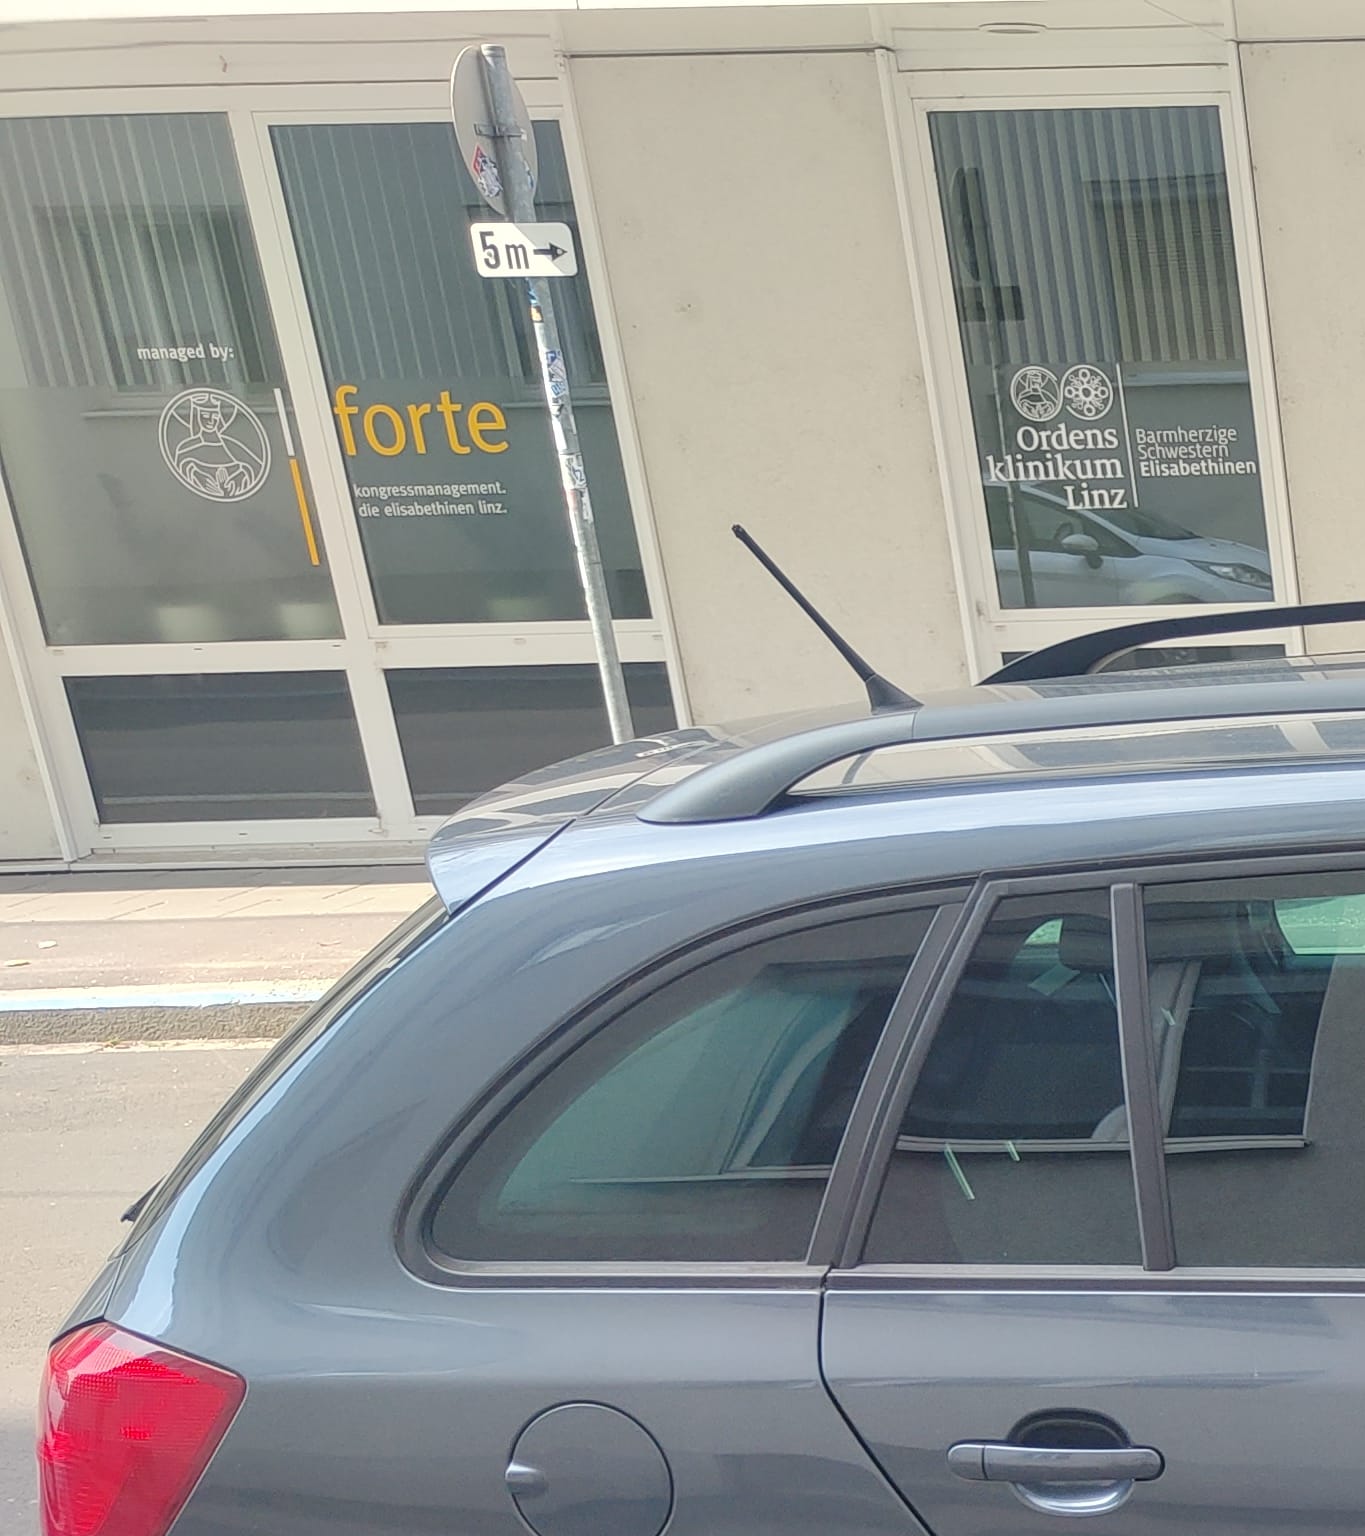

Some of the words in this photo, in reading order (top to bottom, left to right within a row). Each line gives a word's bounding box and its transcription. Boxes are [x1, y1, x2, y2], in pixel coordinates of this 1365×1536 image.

[137, 344, 205, 362] managed
[208, 342, 235, 361] by:
[334, 385, 509, 457] forte
[1016, 423, 1119, 451] Ordens
[1135, 424, 1238, 445] Barmherzige
[1137, 441, 1230, 460] Schwestern
[985, 452, 1125, 482] klinikum
[1140, 458, 1257, 477] Elisabethinen
[353, 481, 508, 500] kongressmanagement.
[1063, 481, 1128, 510] Linz
[358, 502, 381, 518] die
[384, 499, 475, 517] elisabethinen
[478, 498, 508, 515] linz.
